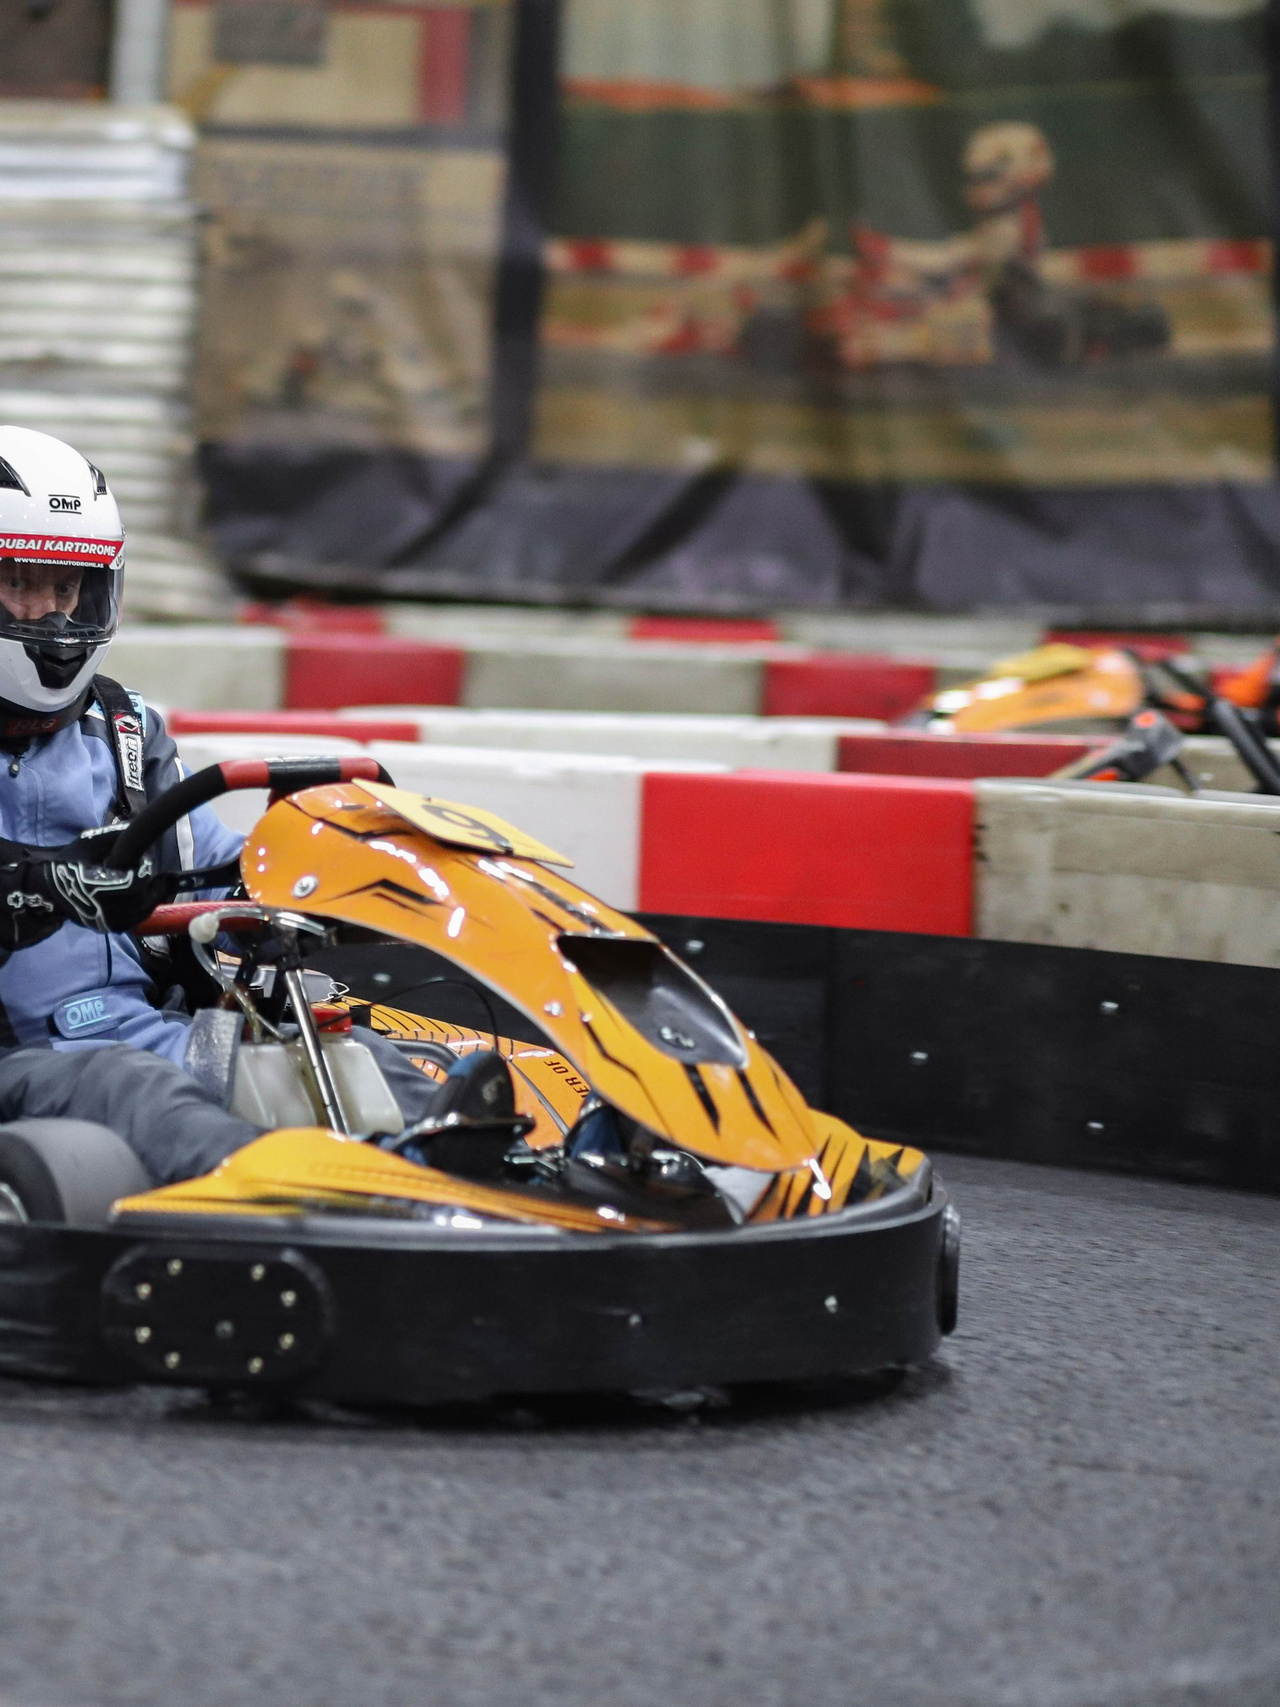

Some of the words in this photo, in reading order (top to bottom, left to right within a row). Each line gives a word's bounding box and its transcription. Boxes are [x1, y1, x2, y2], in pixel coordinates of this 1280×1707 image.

[48, 496, 82, 511] OMP
[43, 539, 117, 558] KARTDROME
[66, 999, 105, 1026] OMP
[543, 1060, 569, 1074] OF
[565, 1077, 591, 1099] ER
